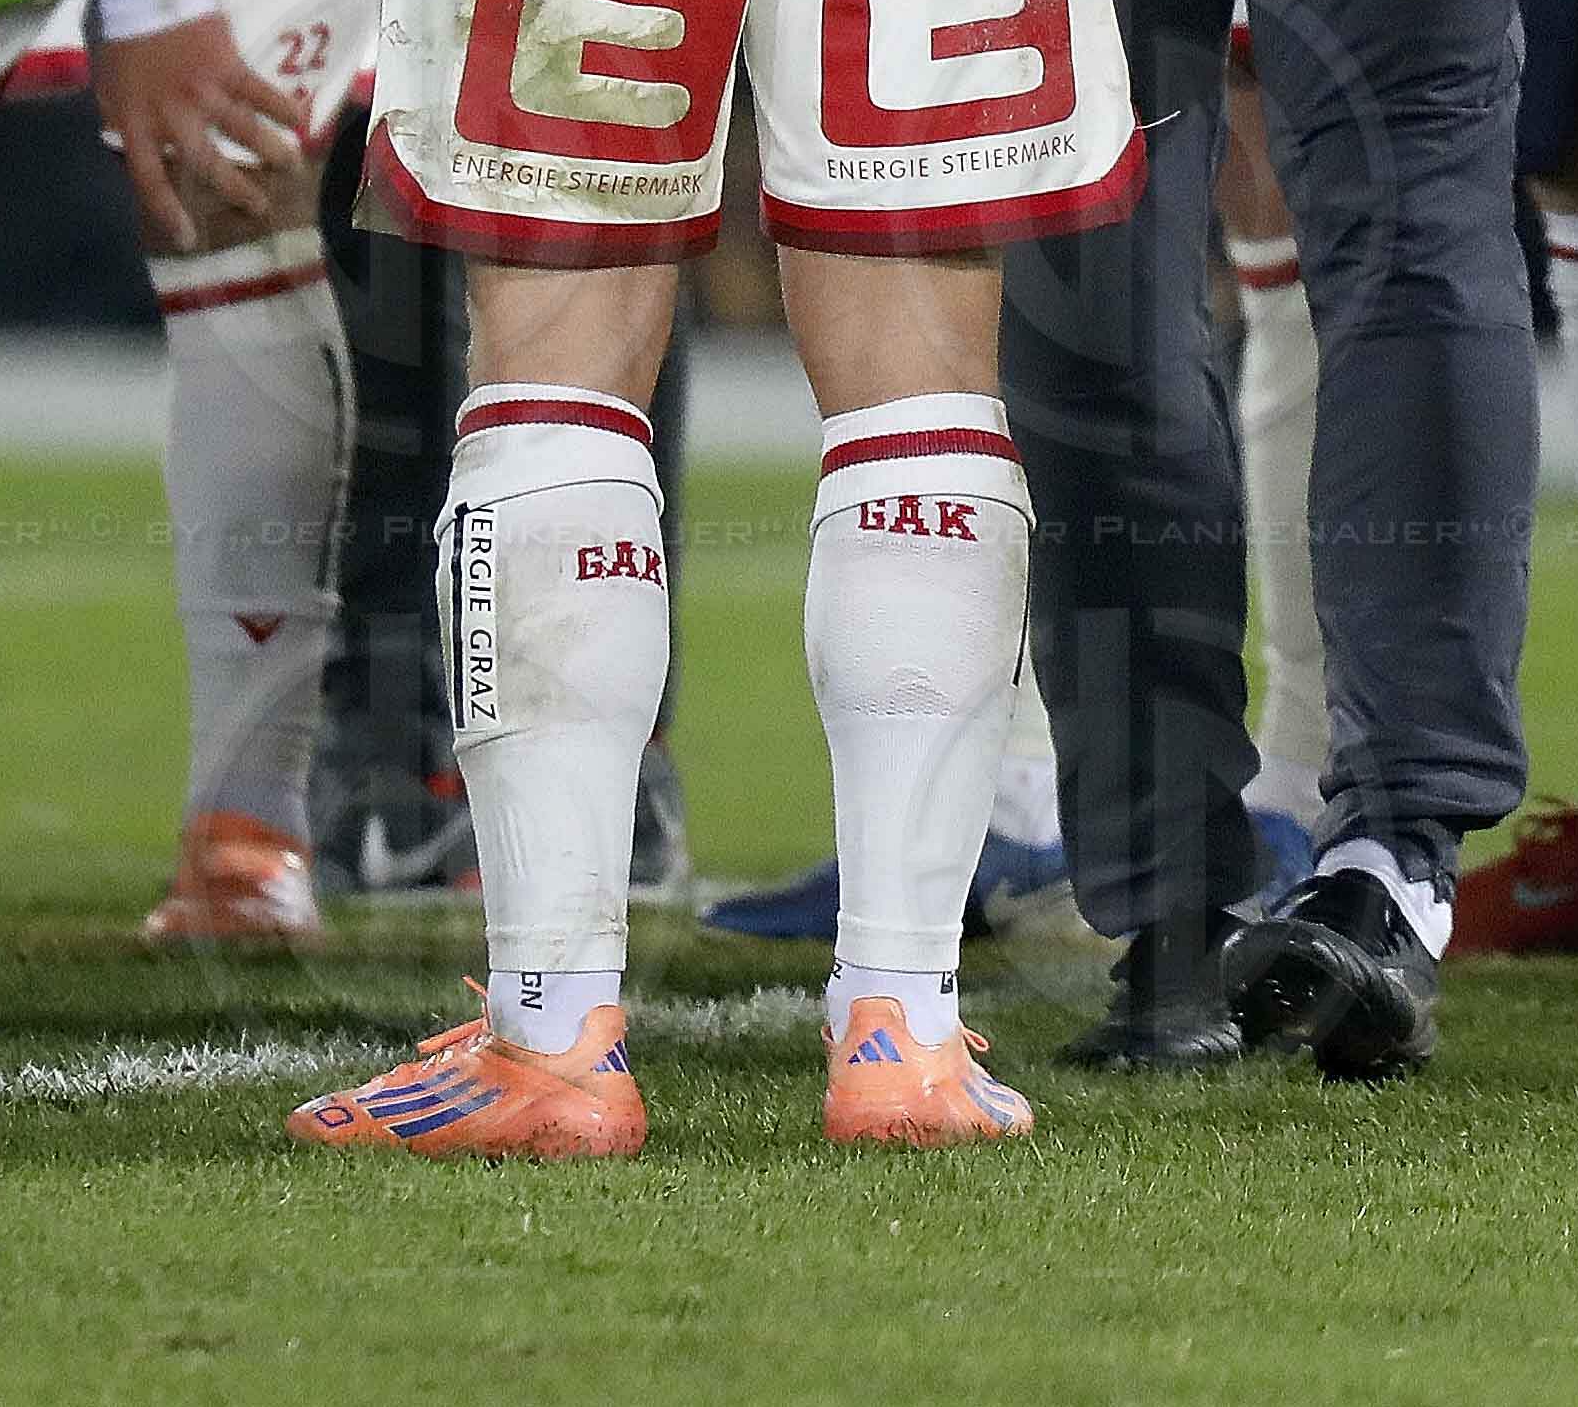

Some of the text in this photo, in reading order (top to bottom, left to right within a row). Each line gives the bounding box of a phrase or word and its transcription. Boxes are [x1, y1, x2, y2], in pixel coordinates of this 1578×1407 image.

[277, 21, 332, 76] 22
[452, 150, 704, 198] ENERGIE STEIERMARK
[826, 132, 1078, 182] ENERGIE STEIERMARK
[858, 494, 979, 543] GAK
[575, 540, 665, 591] GAK
[469, 629, 497, 721] GRAZ
